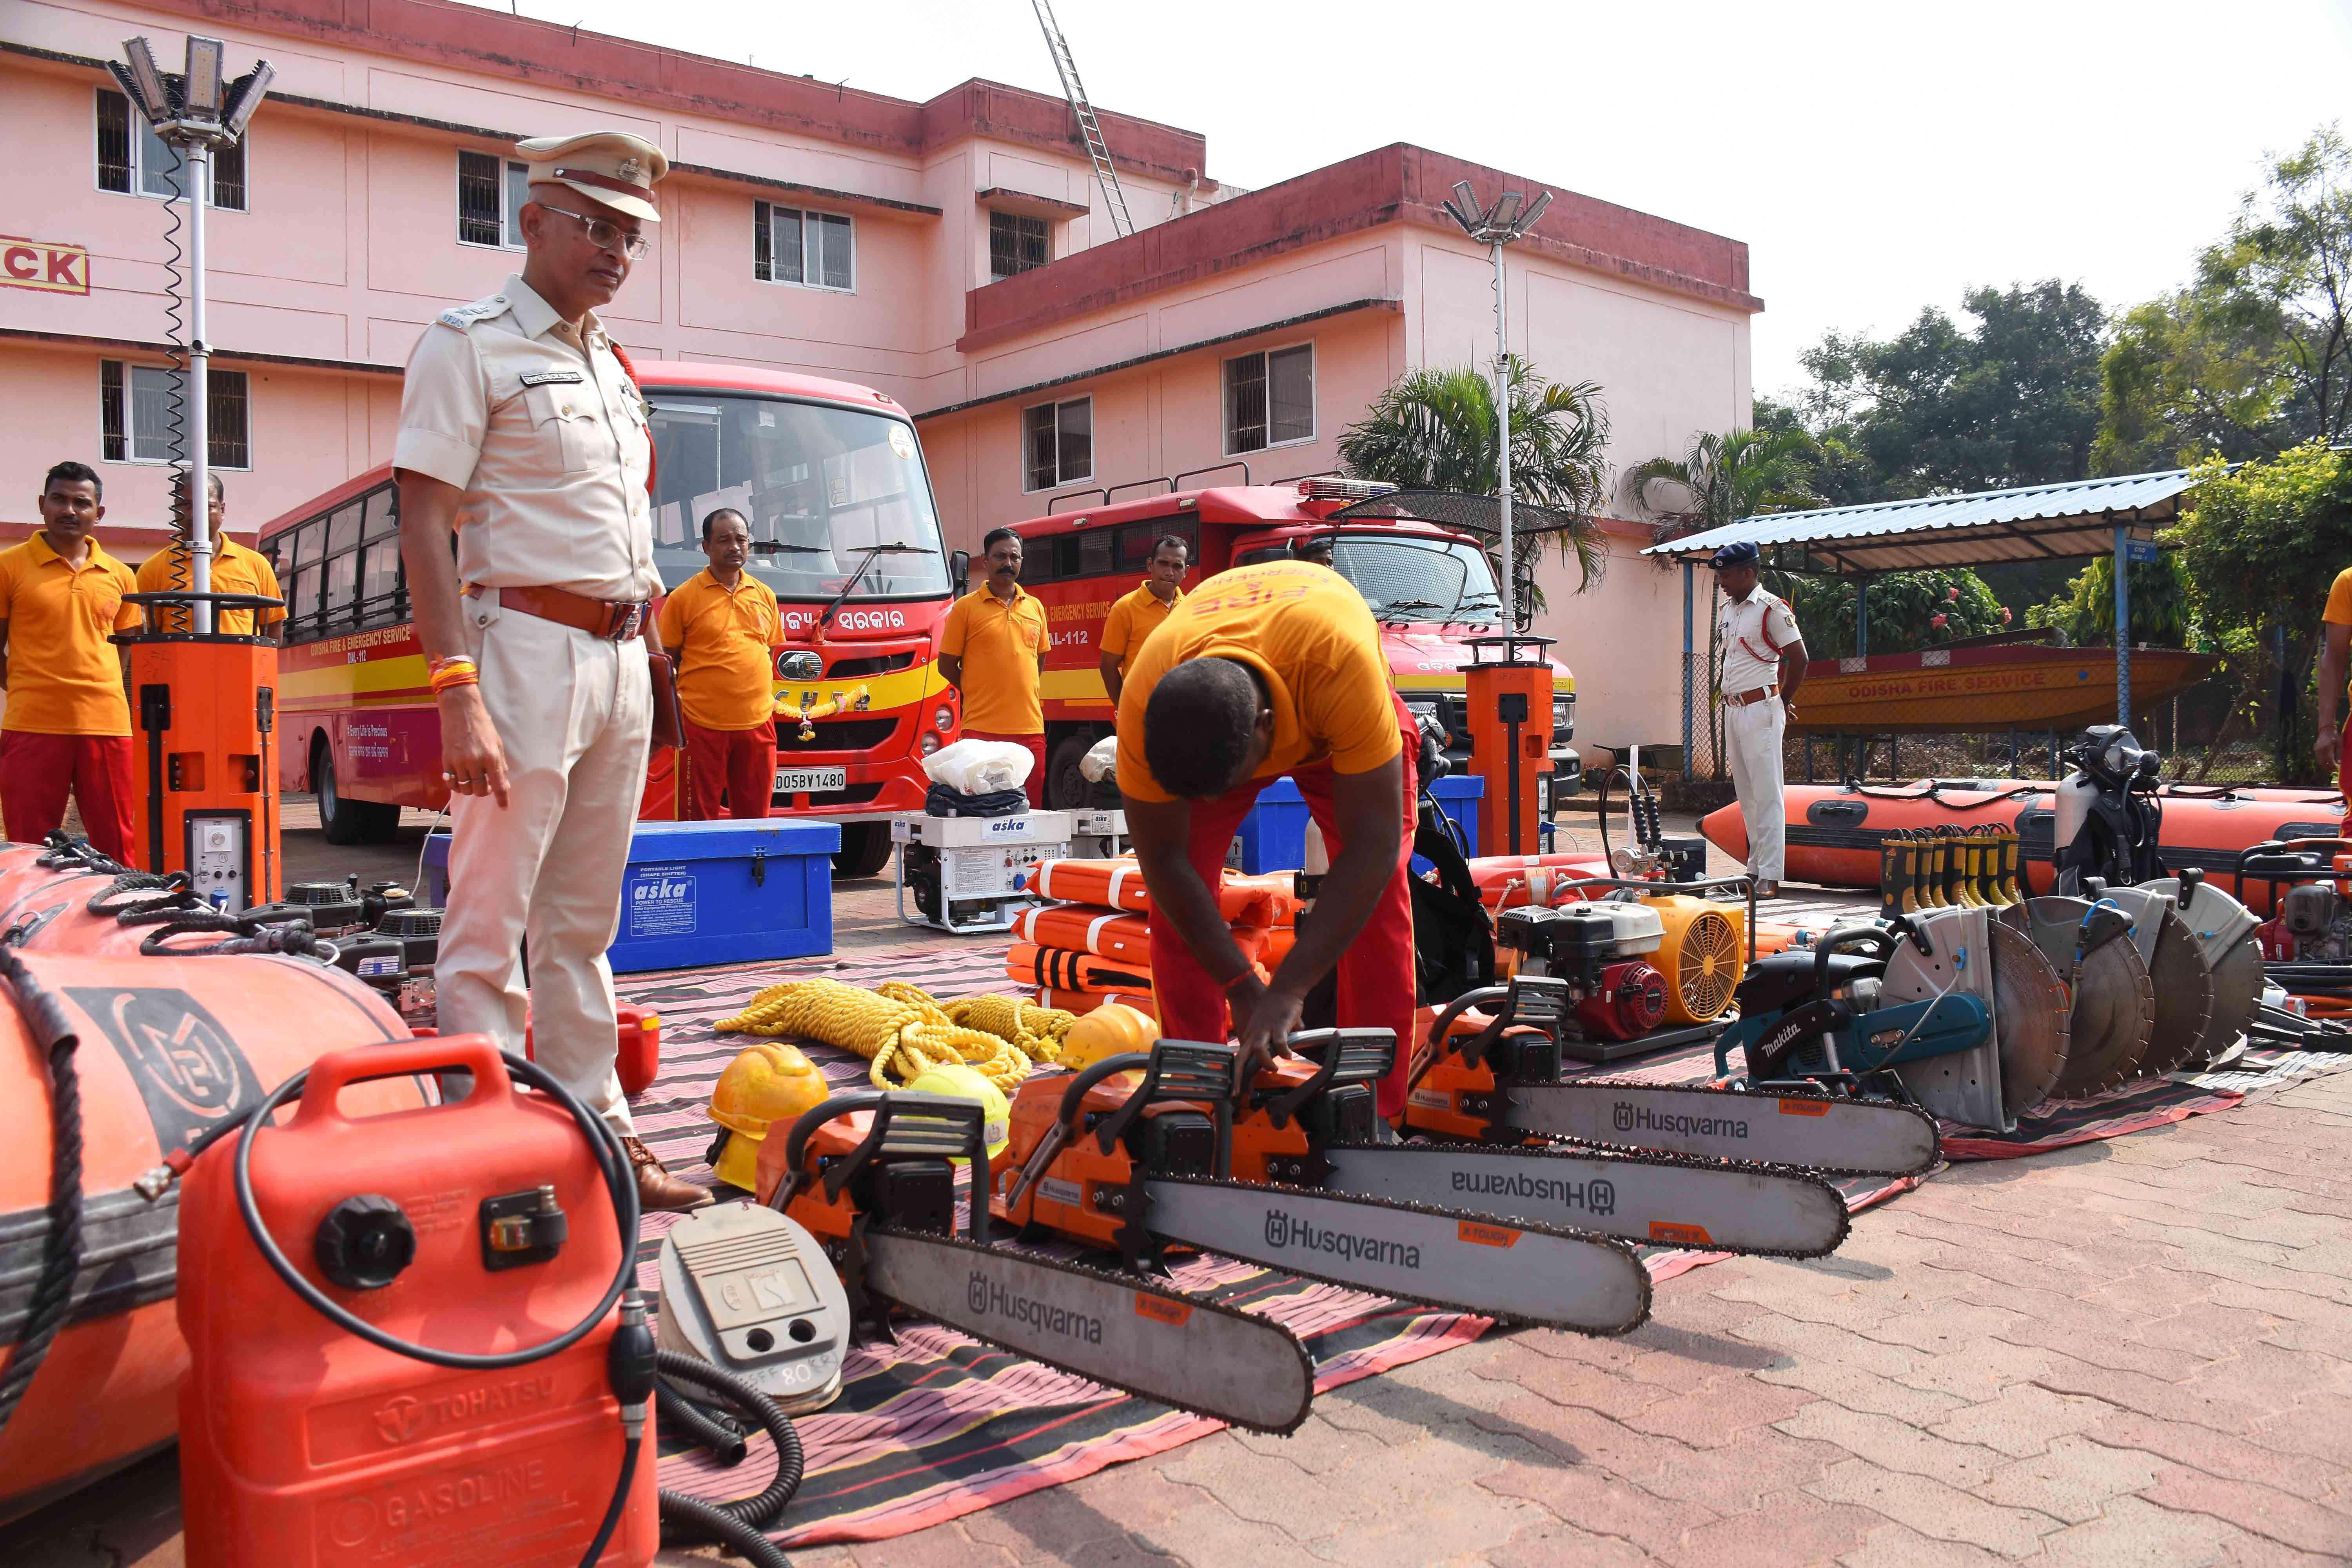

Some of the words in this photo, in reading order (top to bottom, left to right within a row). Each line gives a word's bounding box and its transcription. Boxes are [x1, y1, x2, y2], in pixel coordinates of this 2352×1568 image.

[4, 247, 82, 286] CK
[1049, 603, 1085, 622] EMERGENCY
[1086, 601, 1110, 619] SERVICE
[311, 641, 329, 657] ODISHA
[329, 639, 341, 653] FIRE
[342, 638, 346, 651] &
[347, 631, 382, 650] EMERGENCY
[383, 625, 411, 644] SERVICE
[1049, 630, 1088, 646] AL-112
[1849, 683, 1912, 698] ODISHA
[1918, 679, 1957, 692] FIRE
[1965, 672, 2045, 690] SERVICE
[773, 773, 844, 789] D05BV1480
[1636, 1107, 1749, 1139] Husqvarna
[1451, 1171, 1584, 1208] Husqvarna
[1289, 1222, 1421, 1269] Husqvarna
[989, 1280, 1103, 1345] Husqvarna
[782, 1364, 810, 1385] 80
[434, 1374, 555, 1423] TOHATSU
[386, 1460, 546, 1527] GASOLINE
